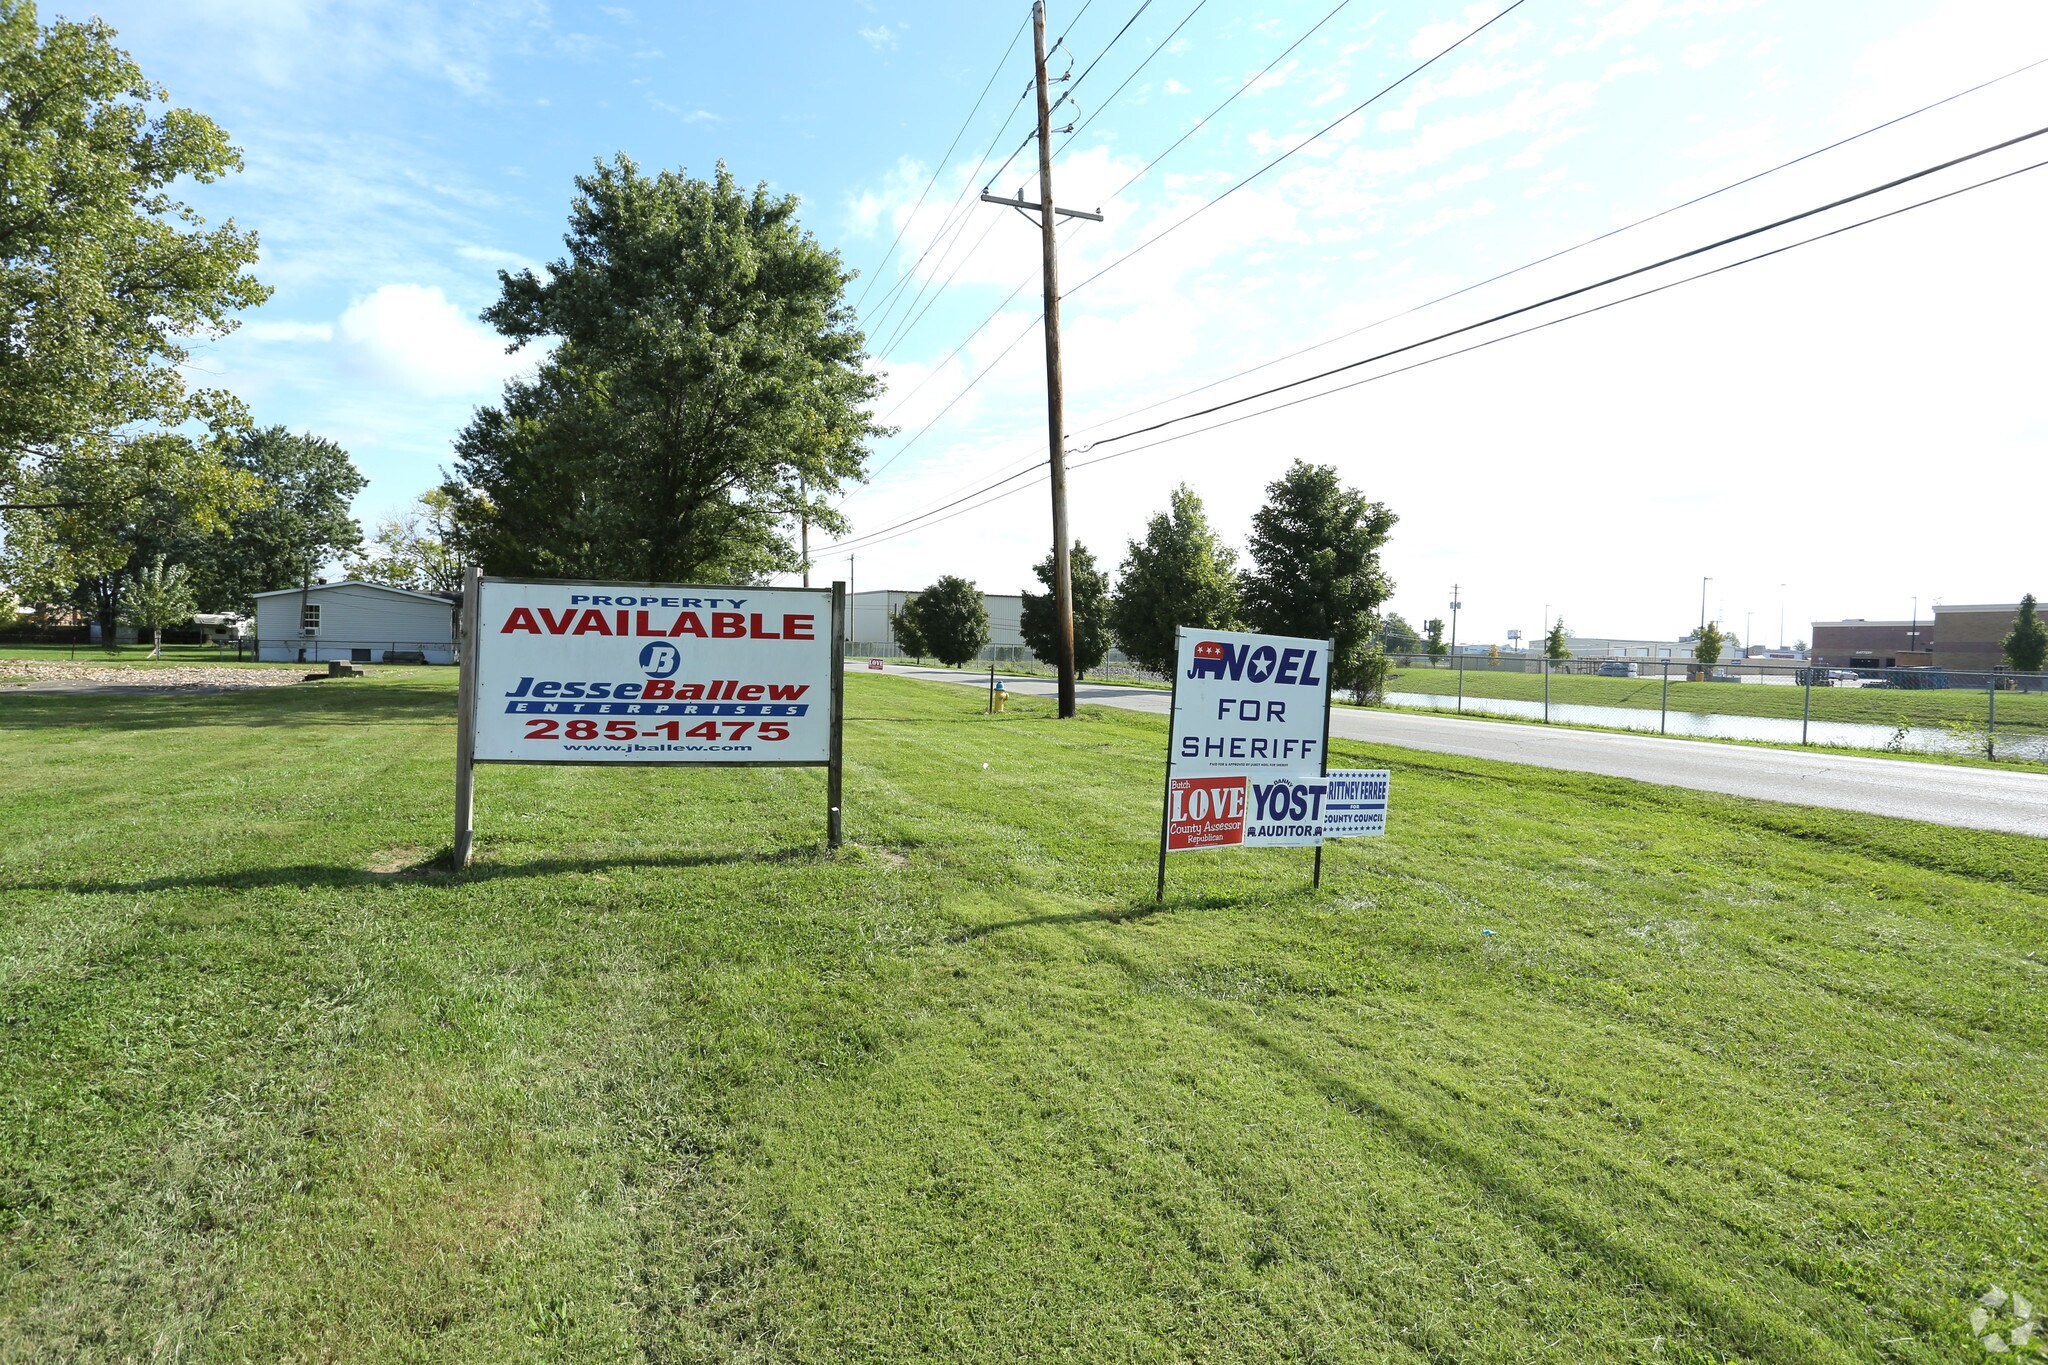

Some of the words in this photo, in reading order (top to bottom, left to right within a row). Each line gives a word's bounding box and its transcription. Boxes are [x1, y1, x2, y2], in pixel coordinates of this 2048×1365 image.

[571, 594, 748, 609] PROPERTY
[500, 607, 815, 640] AVAILABLE
[1214, 641, 1320, 686] NOEL
[515, 703, 798, 715] ENTERPRISES
[1218, 698, 1286, 722] FOR
[524, 719, 790, 741] 285-1475
[563, 744, 752, 753] www.jballew.com
[1181, 736, 1317, 759] SHERIFF
[1171, 780, 1190, 789] Butch
[1273, 778, 1293, 787] DANNY
[1327, 781, 1360, 800] RITTNEY
[1360, 781, 1386, 800] FERREE
[1171, 787, 1244, 822] LOVE
[1253, 784, 1327, 821] YOST
[1353, 814, 1383, 822] COUNCIL
[1170, 823, 1202, 835] County
[1203, 821, 1241, 832] Assessor
[1258, 825, 1313, 837] AUDITOR
[1188, 834, 1224, 844] Republican
